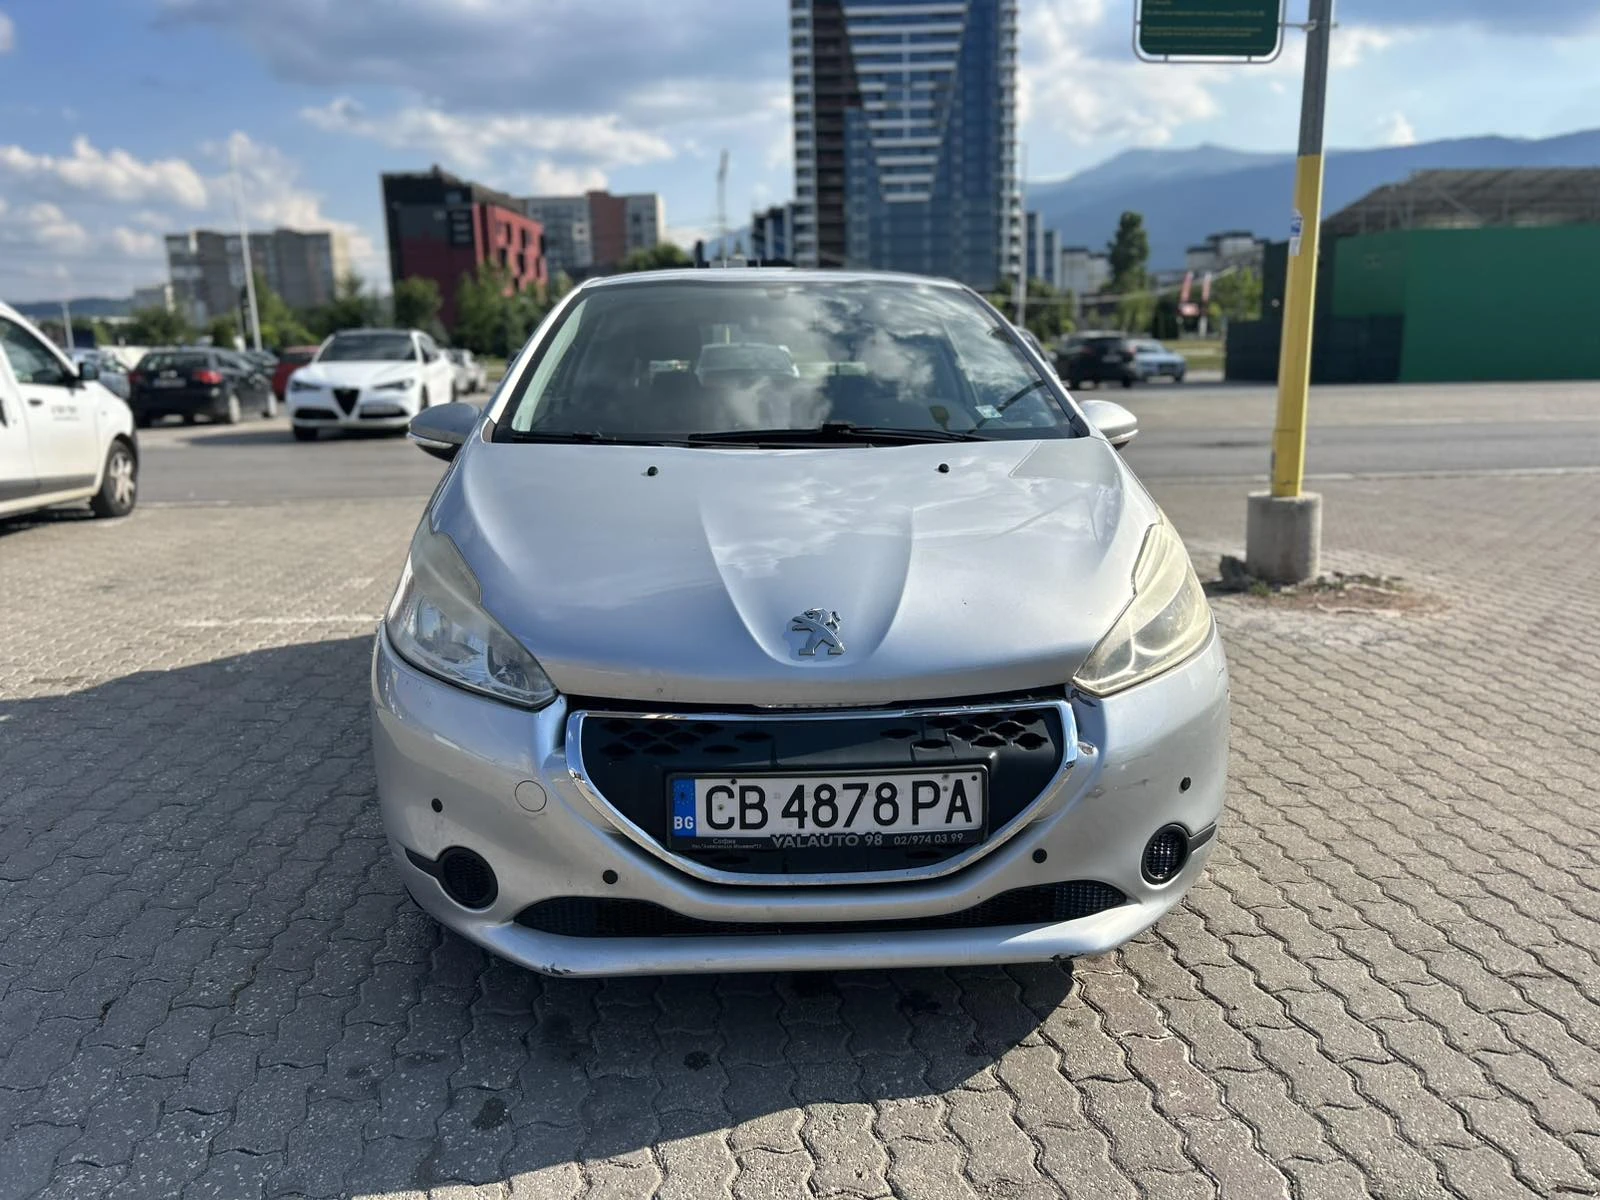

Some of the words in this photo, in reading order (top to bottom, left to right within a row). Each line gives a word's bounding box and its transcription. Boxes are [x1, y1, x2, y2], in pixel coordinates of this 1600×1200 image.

[705, 784, 769, 830] CB
[781, 782, 900, 830] 4878
[912, 779, 973, 826] PA
[673, 815, 694, 831] BG
[771, 834, 859, 848] VALAUTO
[864, 833, 883, 846] 98
[893, 834, 931, 846] 02/974
[934, 834, 948, 844] 03
[950, 832, 964, 843] 99
